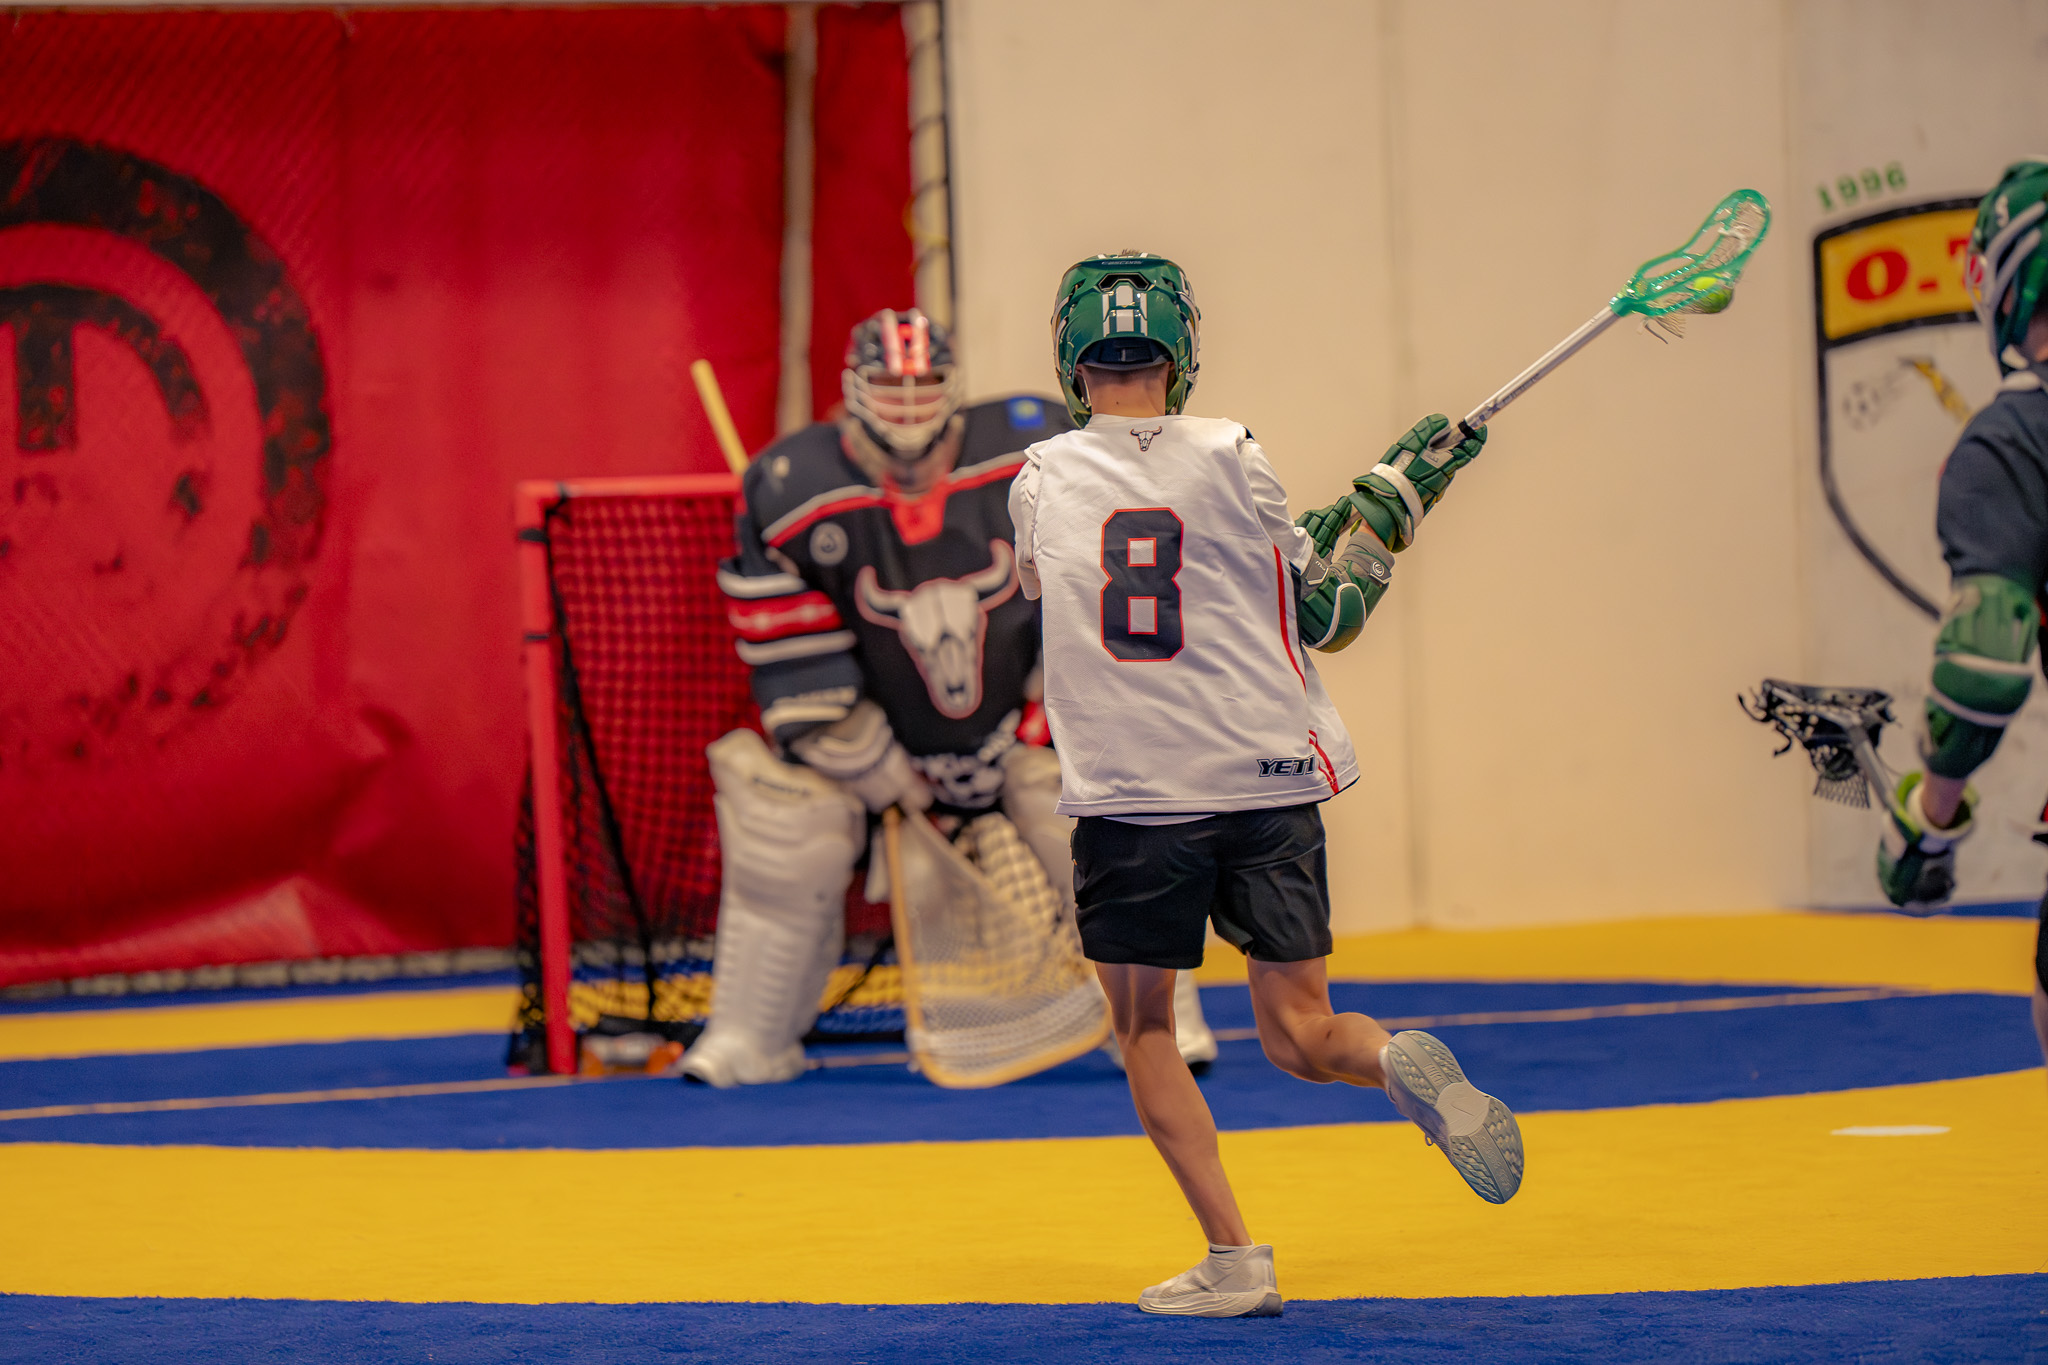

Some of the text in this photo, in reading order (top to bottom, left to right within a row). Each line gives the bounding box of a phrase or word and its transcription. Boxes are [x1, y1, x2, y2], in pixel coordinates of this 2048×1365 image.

[1817, 162, 1906, 211] 1996
[1101, 507, 1184, 662] 8
[1256, 754, 1315, 777] YETI
